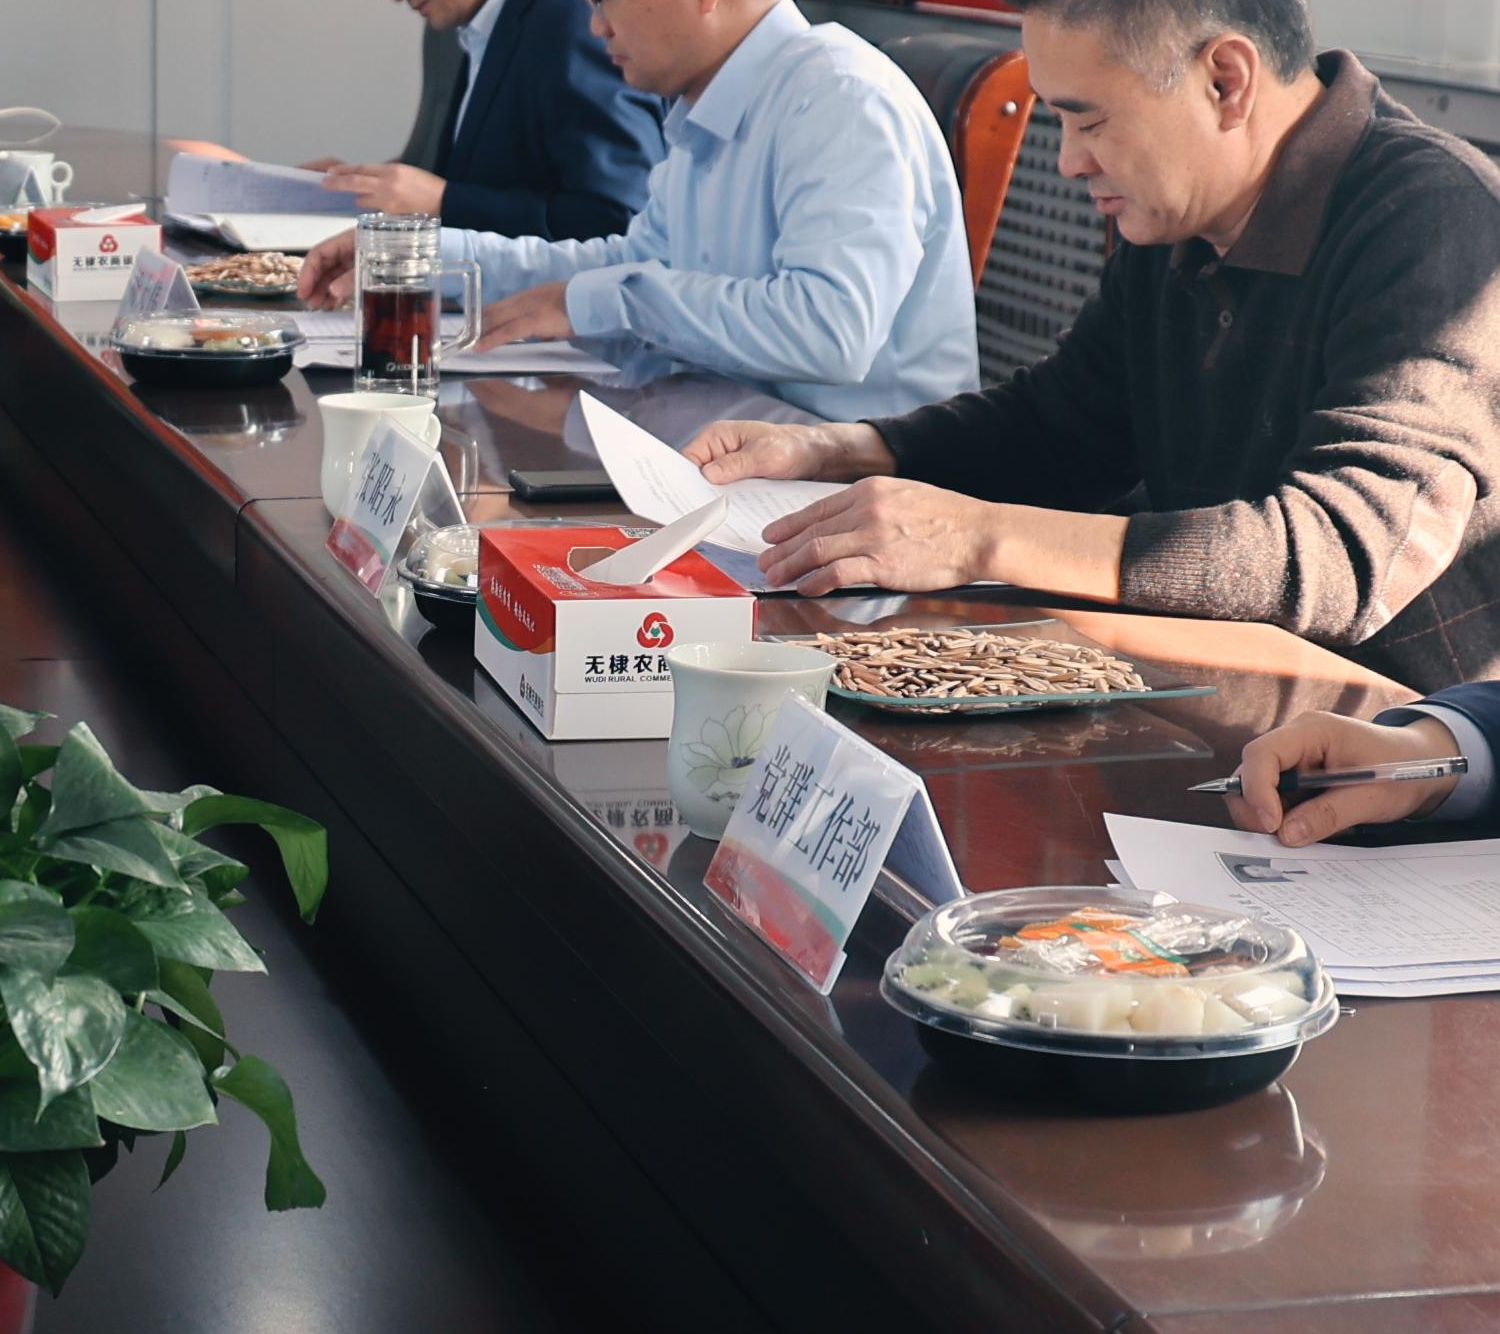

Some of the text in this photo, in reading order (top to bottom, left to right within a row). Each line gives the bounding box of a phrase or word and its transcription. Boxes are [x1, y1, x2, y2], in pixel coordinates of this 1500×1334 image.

[608, 675, 636, 683] RURAL
[747, 744, 881, 892] 党群工作部
